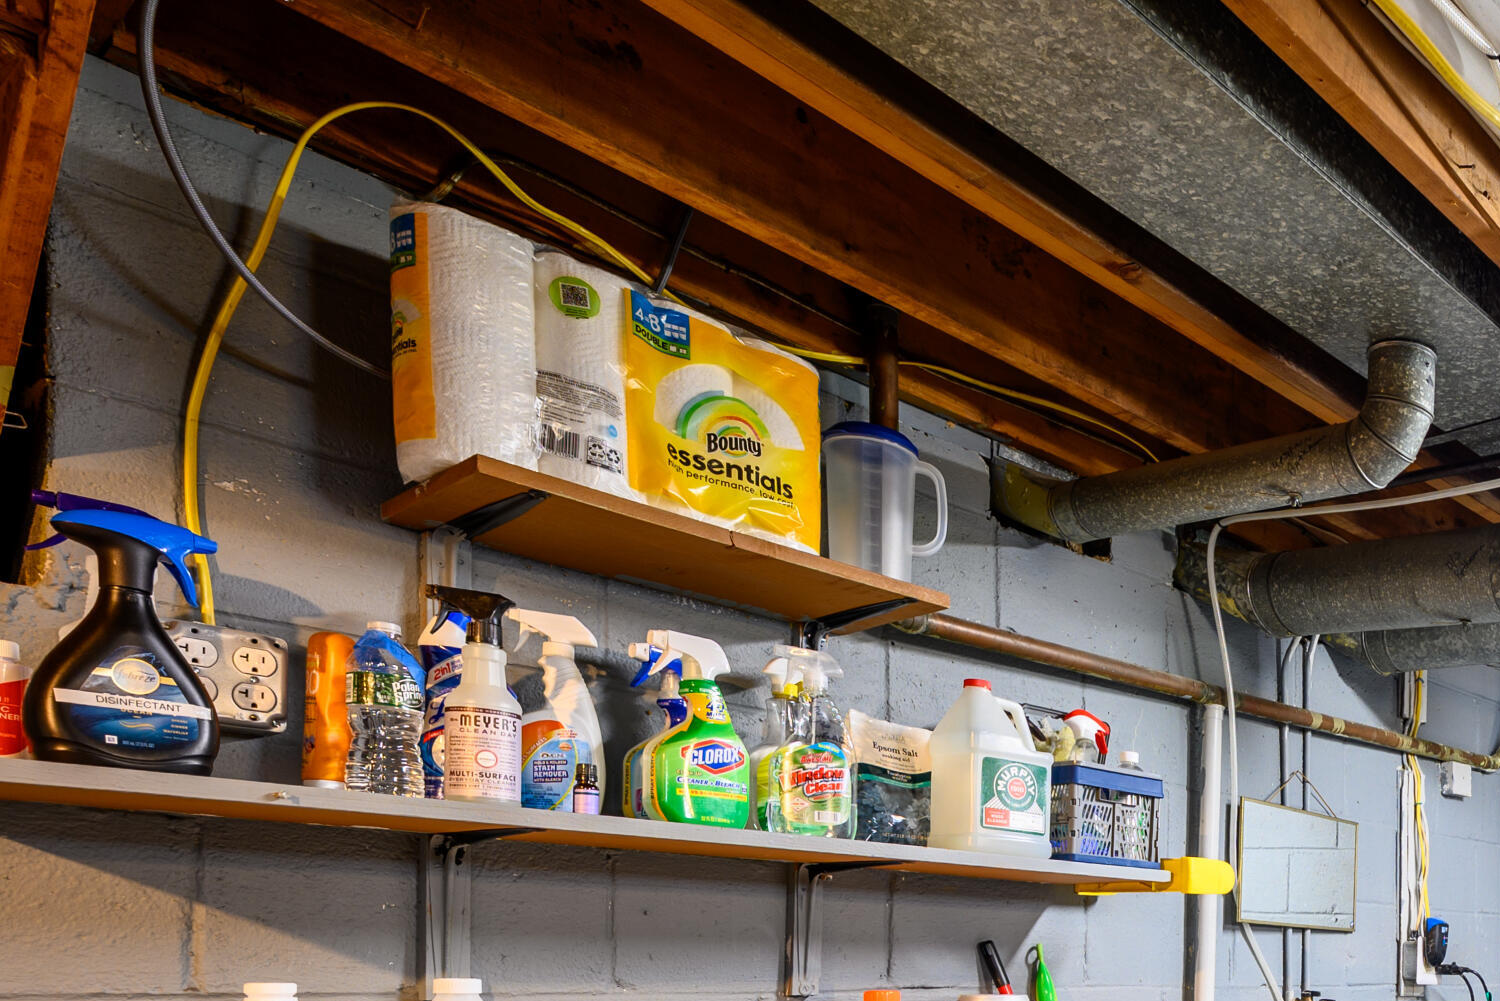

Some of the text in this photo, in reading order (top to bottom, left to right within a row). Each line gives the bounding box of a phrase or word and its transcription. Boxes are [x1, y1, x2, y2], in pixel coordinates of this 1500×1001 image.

[635, 325, 669, 351] DOUBLE
[706, 432, 762, 457] Bounty
[667, 442, 794, 500] essentials
[667, 458, 685, 475] high
[759, 488, 775, 502] low
[95, 694, 183, 714] DISINFECTANT
[459, 727, 498, 736] CLEAN
[460, 713, 518, 733] MEYER'S
[689, 747, 740, 766] CLOROX
[872, 741, 919, 758] Epsom Salt
[533, 770, 568, 778] REMOVER
[779, 766, 846, 791] Window
[997, 766, 1035, 796] MURPHY
[804, 780, 846, 797] Clean
